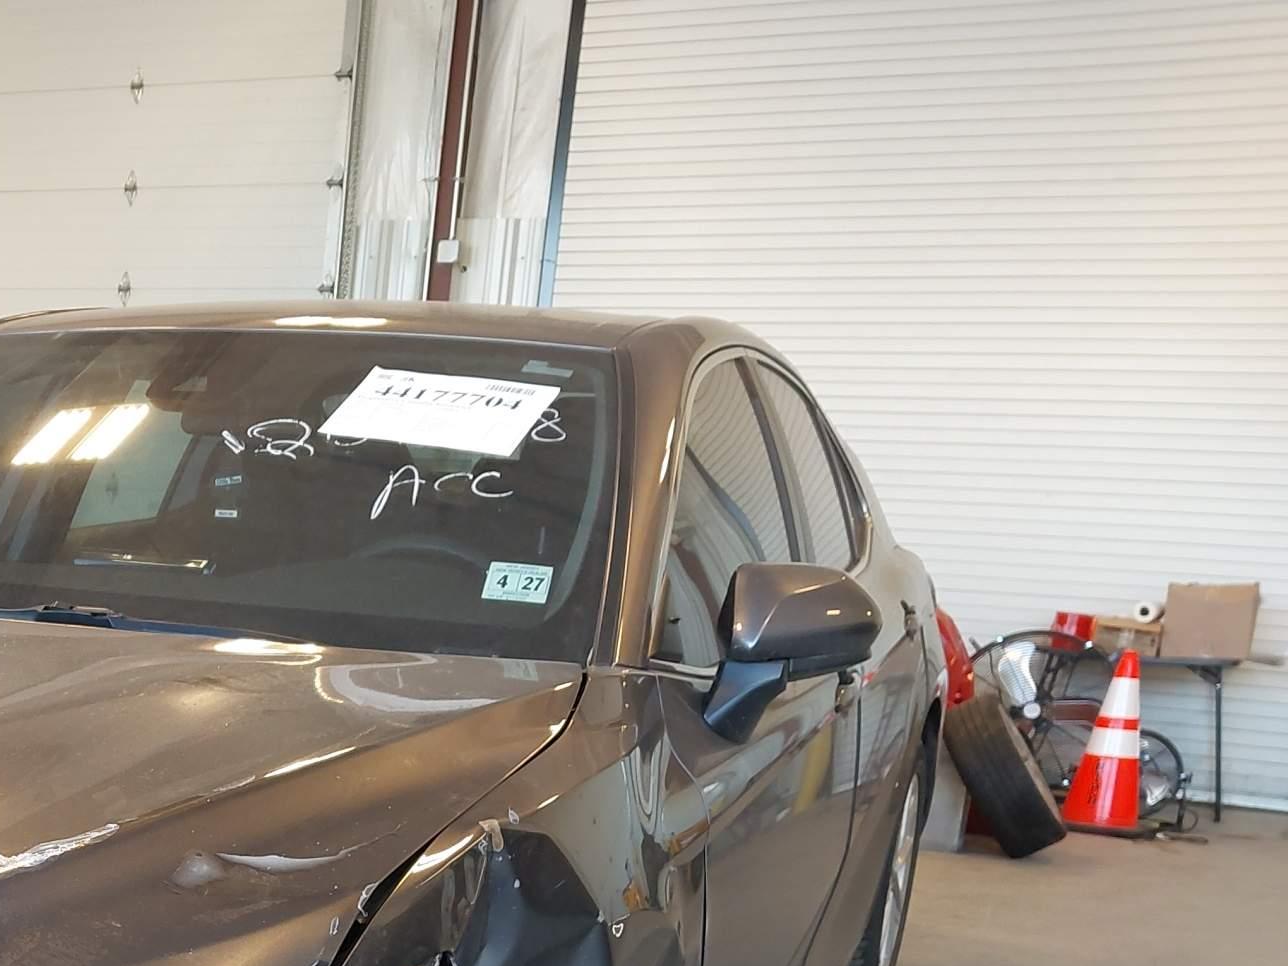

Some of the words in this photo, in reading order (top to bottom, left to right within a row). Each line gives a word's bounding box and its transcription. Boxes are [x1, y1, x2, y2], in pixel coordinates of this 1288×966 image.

[375, 385, 522, 410] 44177704
[496, 574, 510, 589] 4
[521, 576, 546, 592] 27
